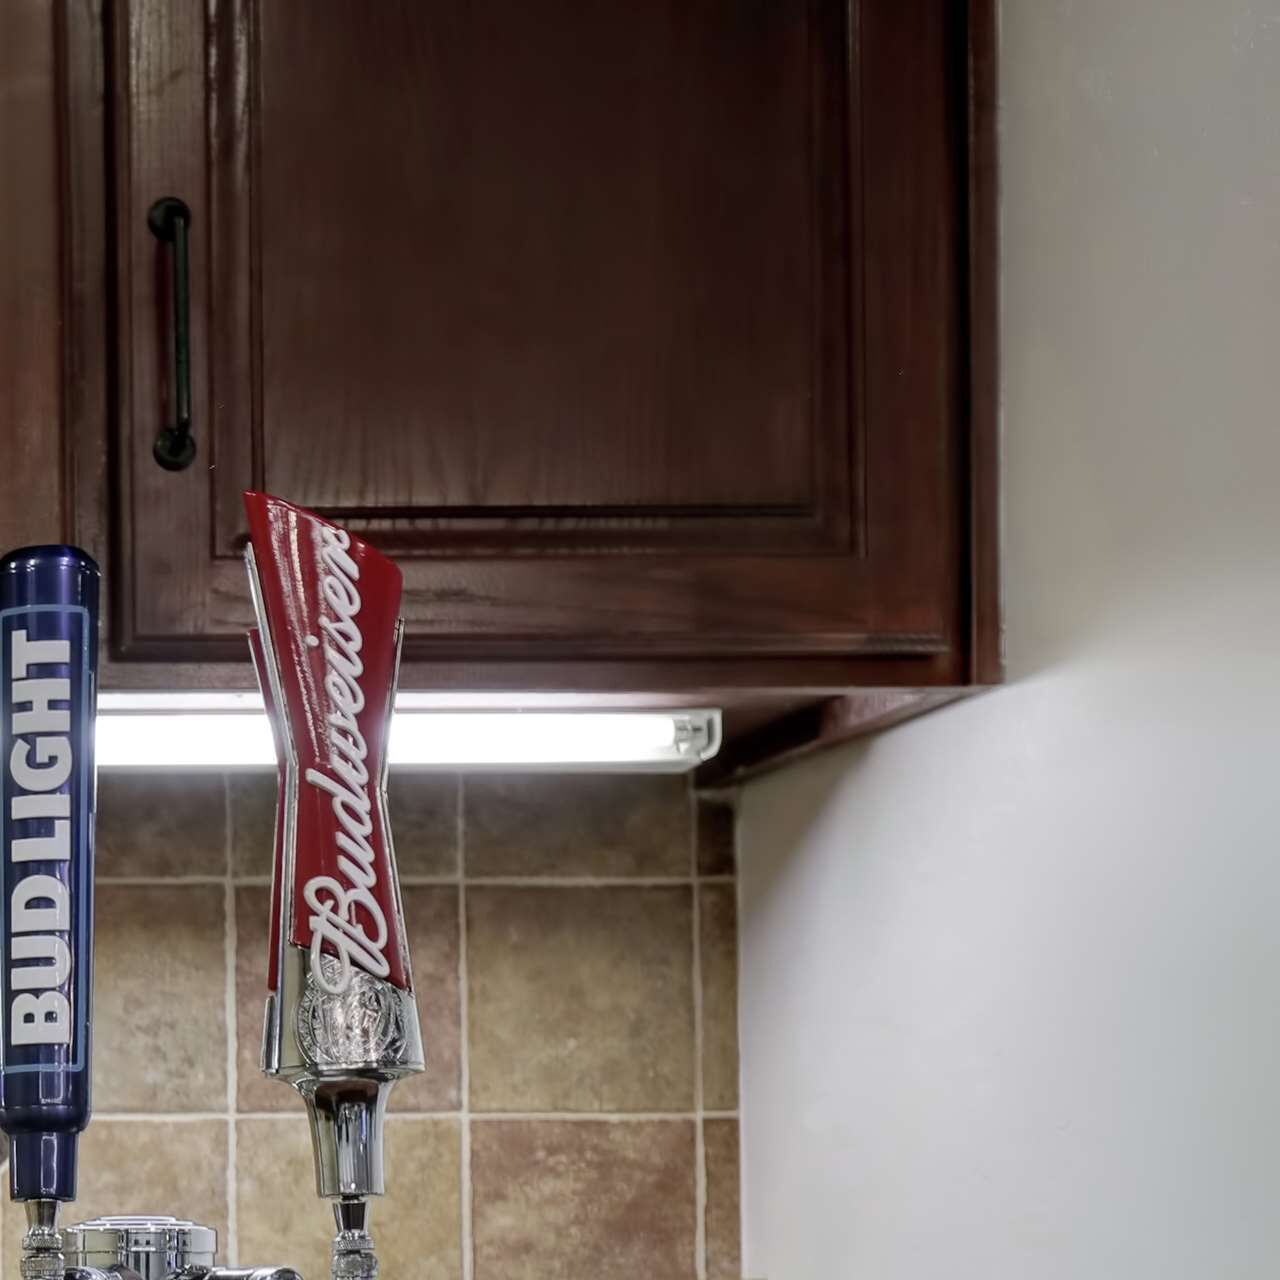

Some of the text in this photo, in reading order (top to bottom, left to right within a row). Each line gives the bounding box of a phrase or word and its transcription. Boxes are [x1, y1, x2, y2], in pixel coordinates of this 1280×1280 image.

[9, 629, 73, 1048] BUD LIGHT
[303, 526, 390, 995] Budweiser
